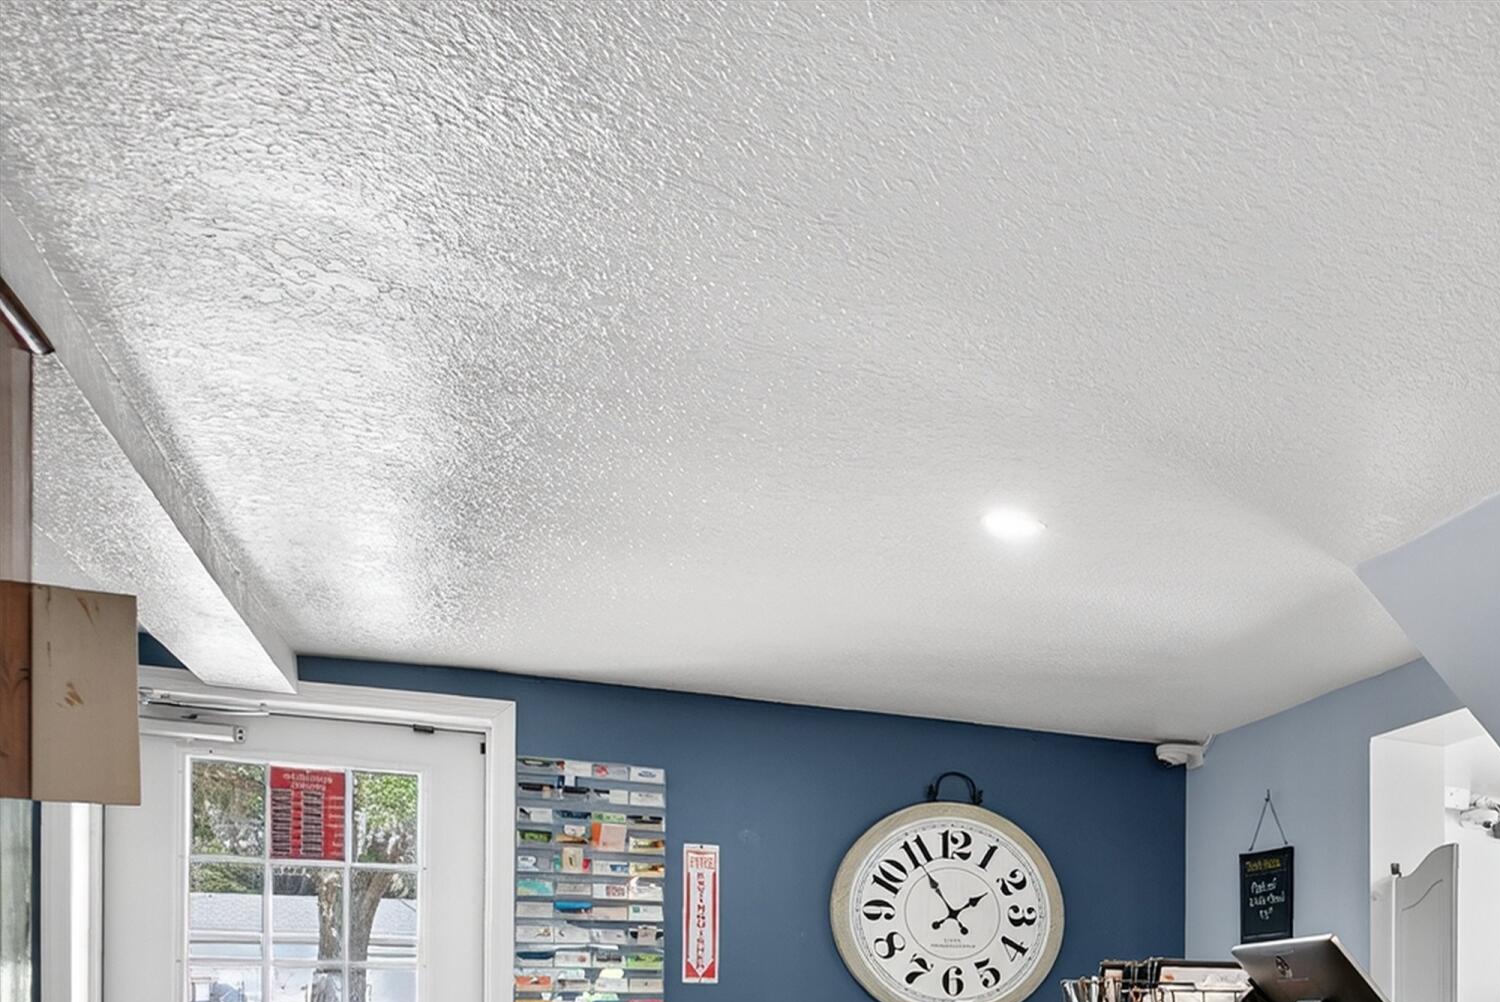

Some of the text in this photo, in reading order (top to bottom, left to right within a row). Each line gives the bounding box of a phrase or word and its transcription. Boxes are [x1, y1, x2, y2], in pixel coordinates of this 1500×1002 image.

[900, 834, 933, 869] 11
[938, 829, 972, 860] 12
[976, 844, 999, 871] 1
[871, 858, 908, 896] 10
[996, 869, 1027, 896] 2
[863, 900, 895, 920] 9
[1008, 905, 1037, 927] 3
[874, 932, 905, 959] 8
[1001, 936, 1029, 962] 4
[905, 954, 933, 984] 7
[942, 966, 963, 996] 6
[974, 958, 1000, 988] 5
